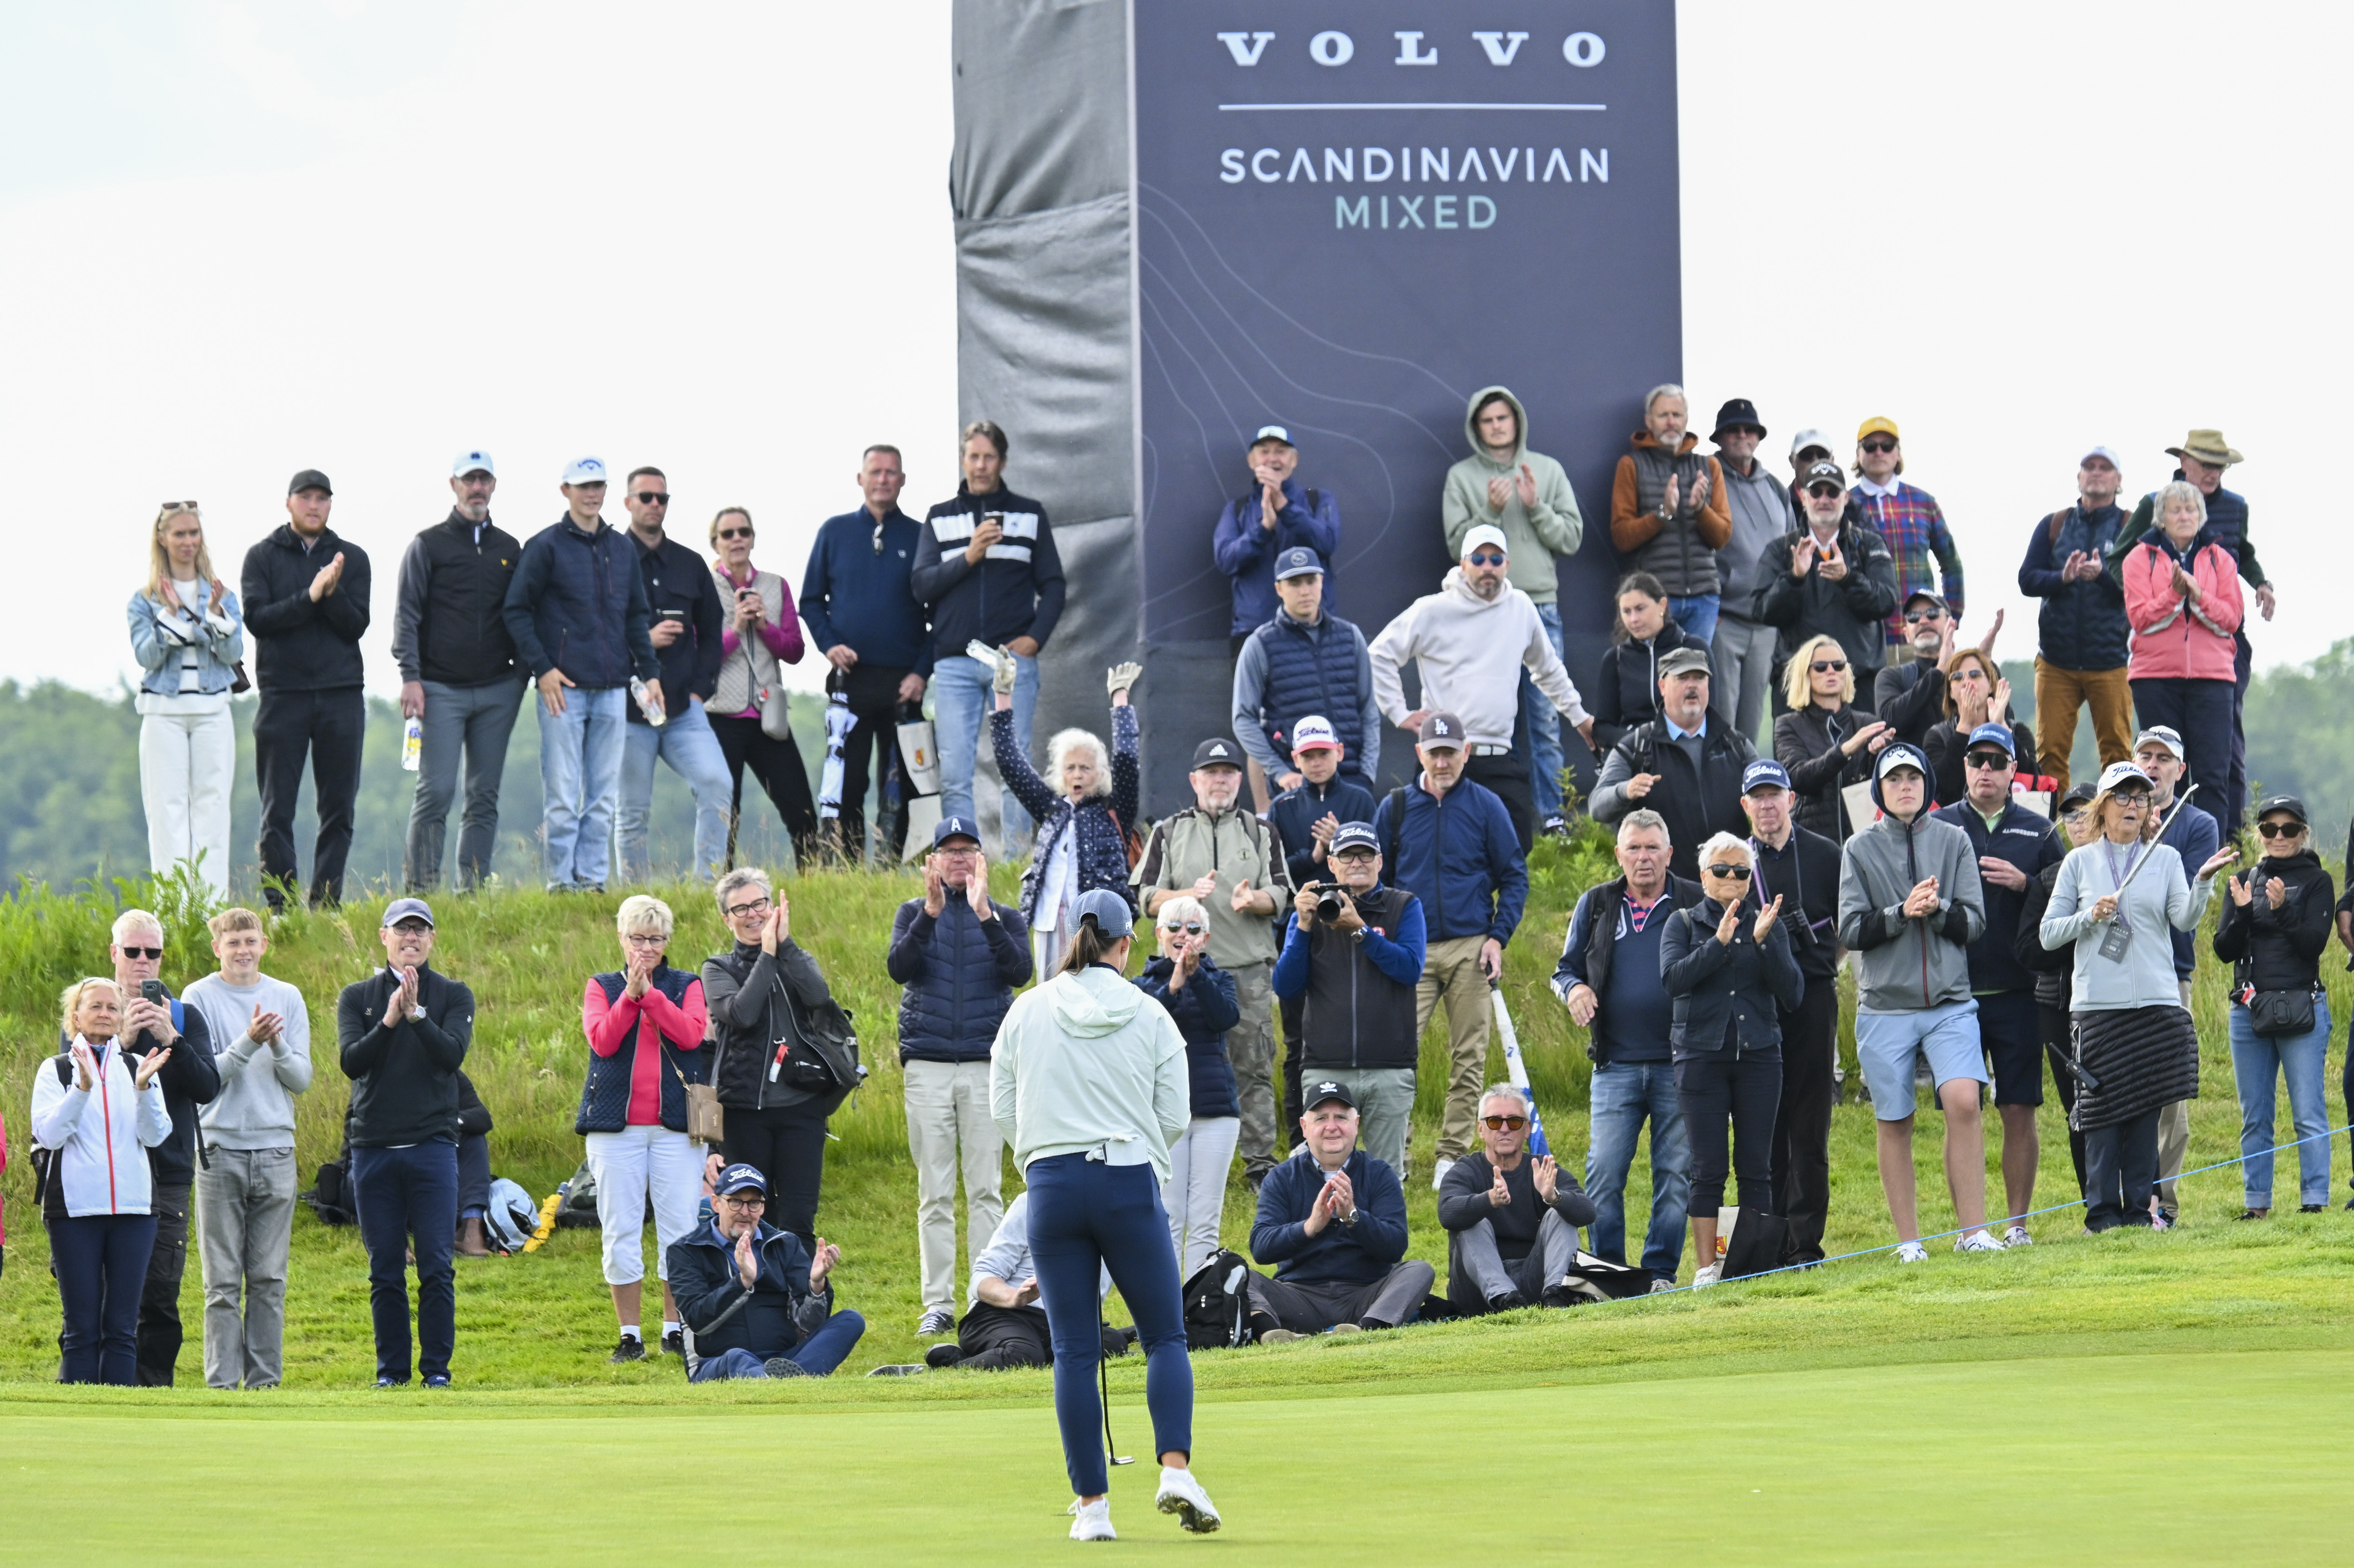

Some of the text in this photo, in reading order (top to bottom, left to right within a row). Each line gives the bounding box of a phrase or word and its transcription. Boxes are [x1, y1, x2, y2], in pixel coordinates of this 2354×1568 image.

[1217, 31, 1606, 67] VOLVO
[1219, 147, 1609, 183] SCANDINAVIAN
[1336, 195, 1497, 229] MIXED
[1435, 718, 1448, 735] LA
[1745, 765, 1782, 783] Titleist
[951, 818, 962, 831] A
[1337, 827, 1376, 841] Titleist
[728, 1168, 764, 1182] Titleist
